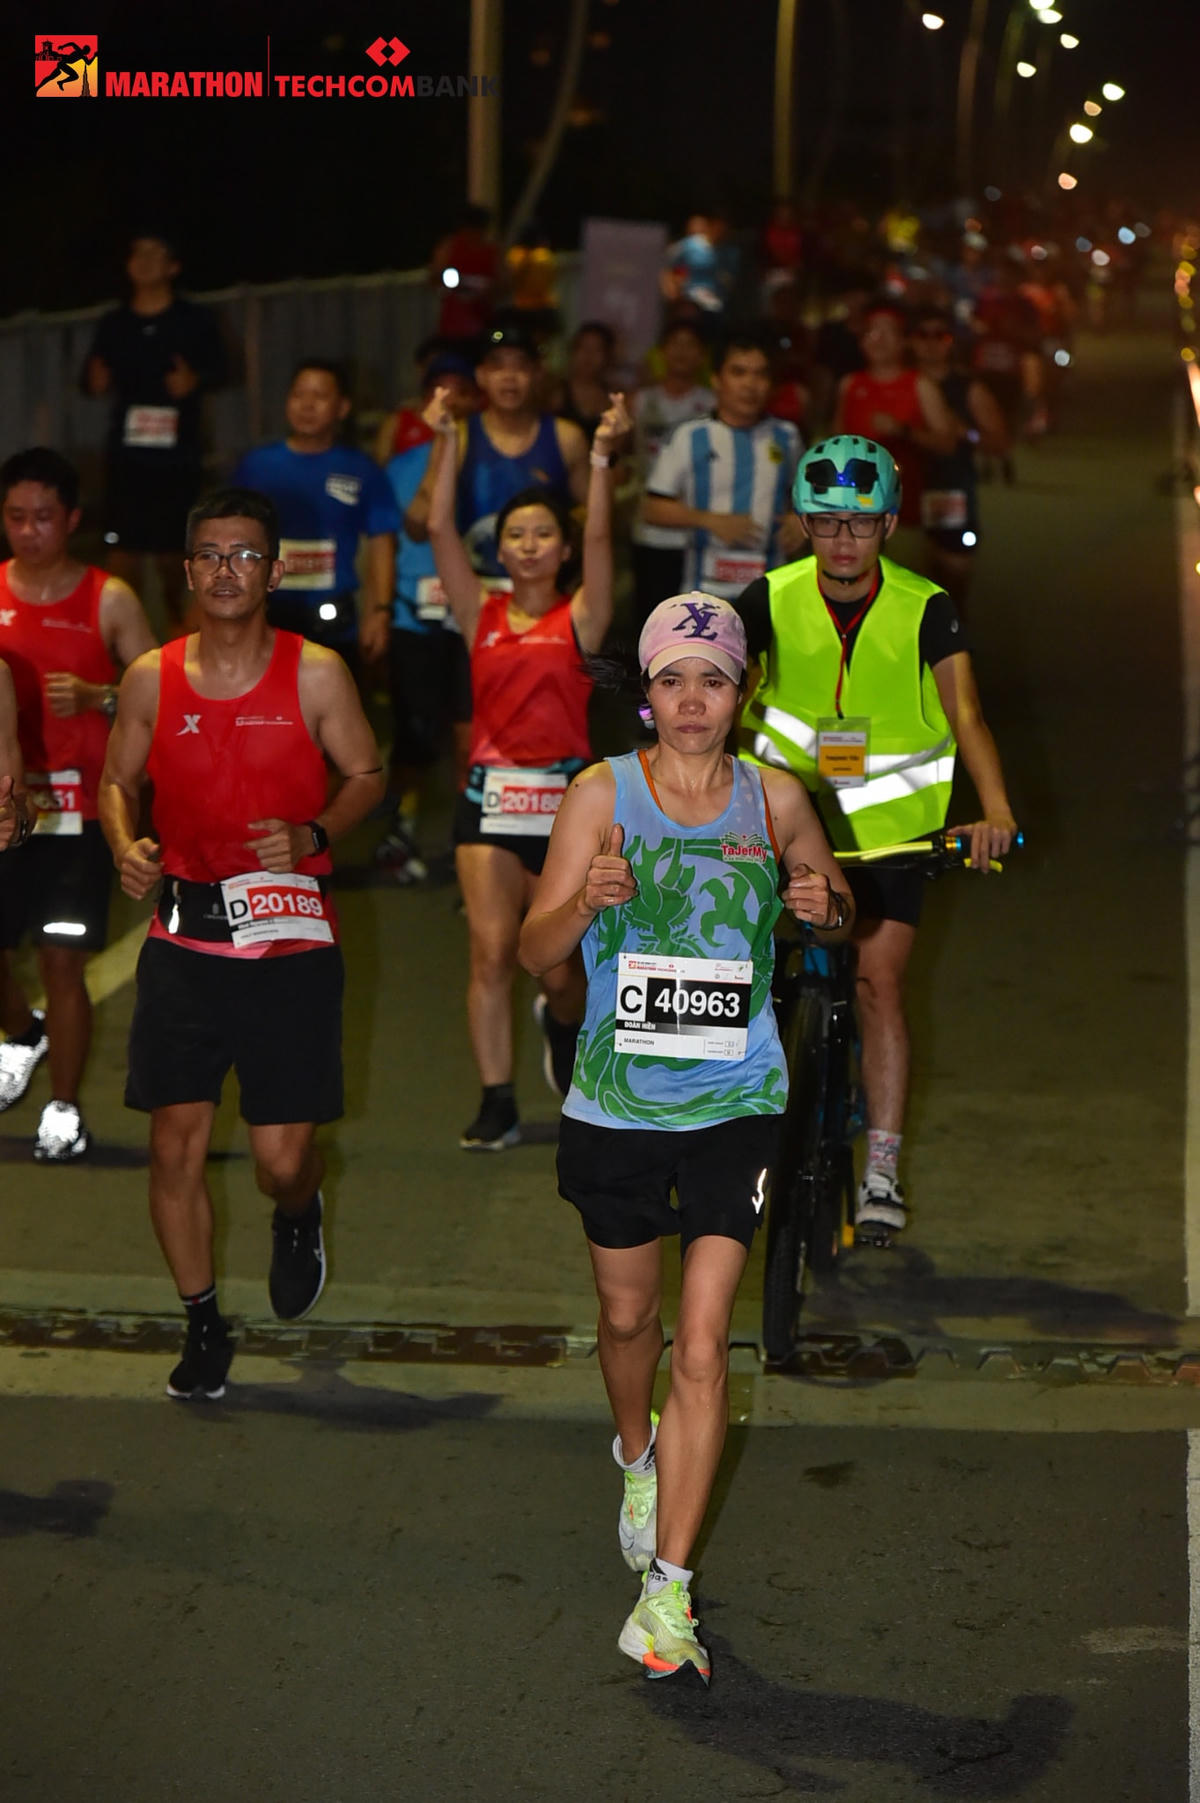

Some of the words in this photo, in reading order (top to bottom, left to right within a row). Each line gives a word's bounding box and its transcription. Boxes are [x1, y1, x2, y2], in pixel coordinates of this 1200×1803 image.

[487, 792, 501, 809] D
[229, 899, 248, 920] D
[251, 892, 323, 917] 20189
[620, 985, 643, 1014] C
[654, 988, 741, 1018] 40963
[623, 1037, 655, 1046] MARATHON
